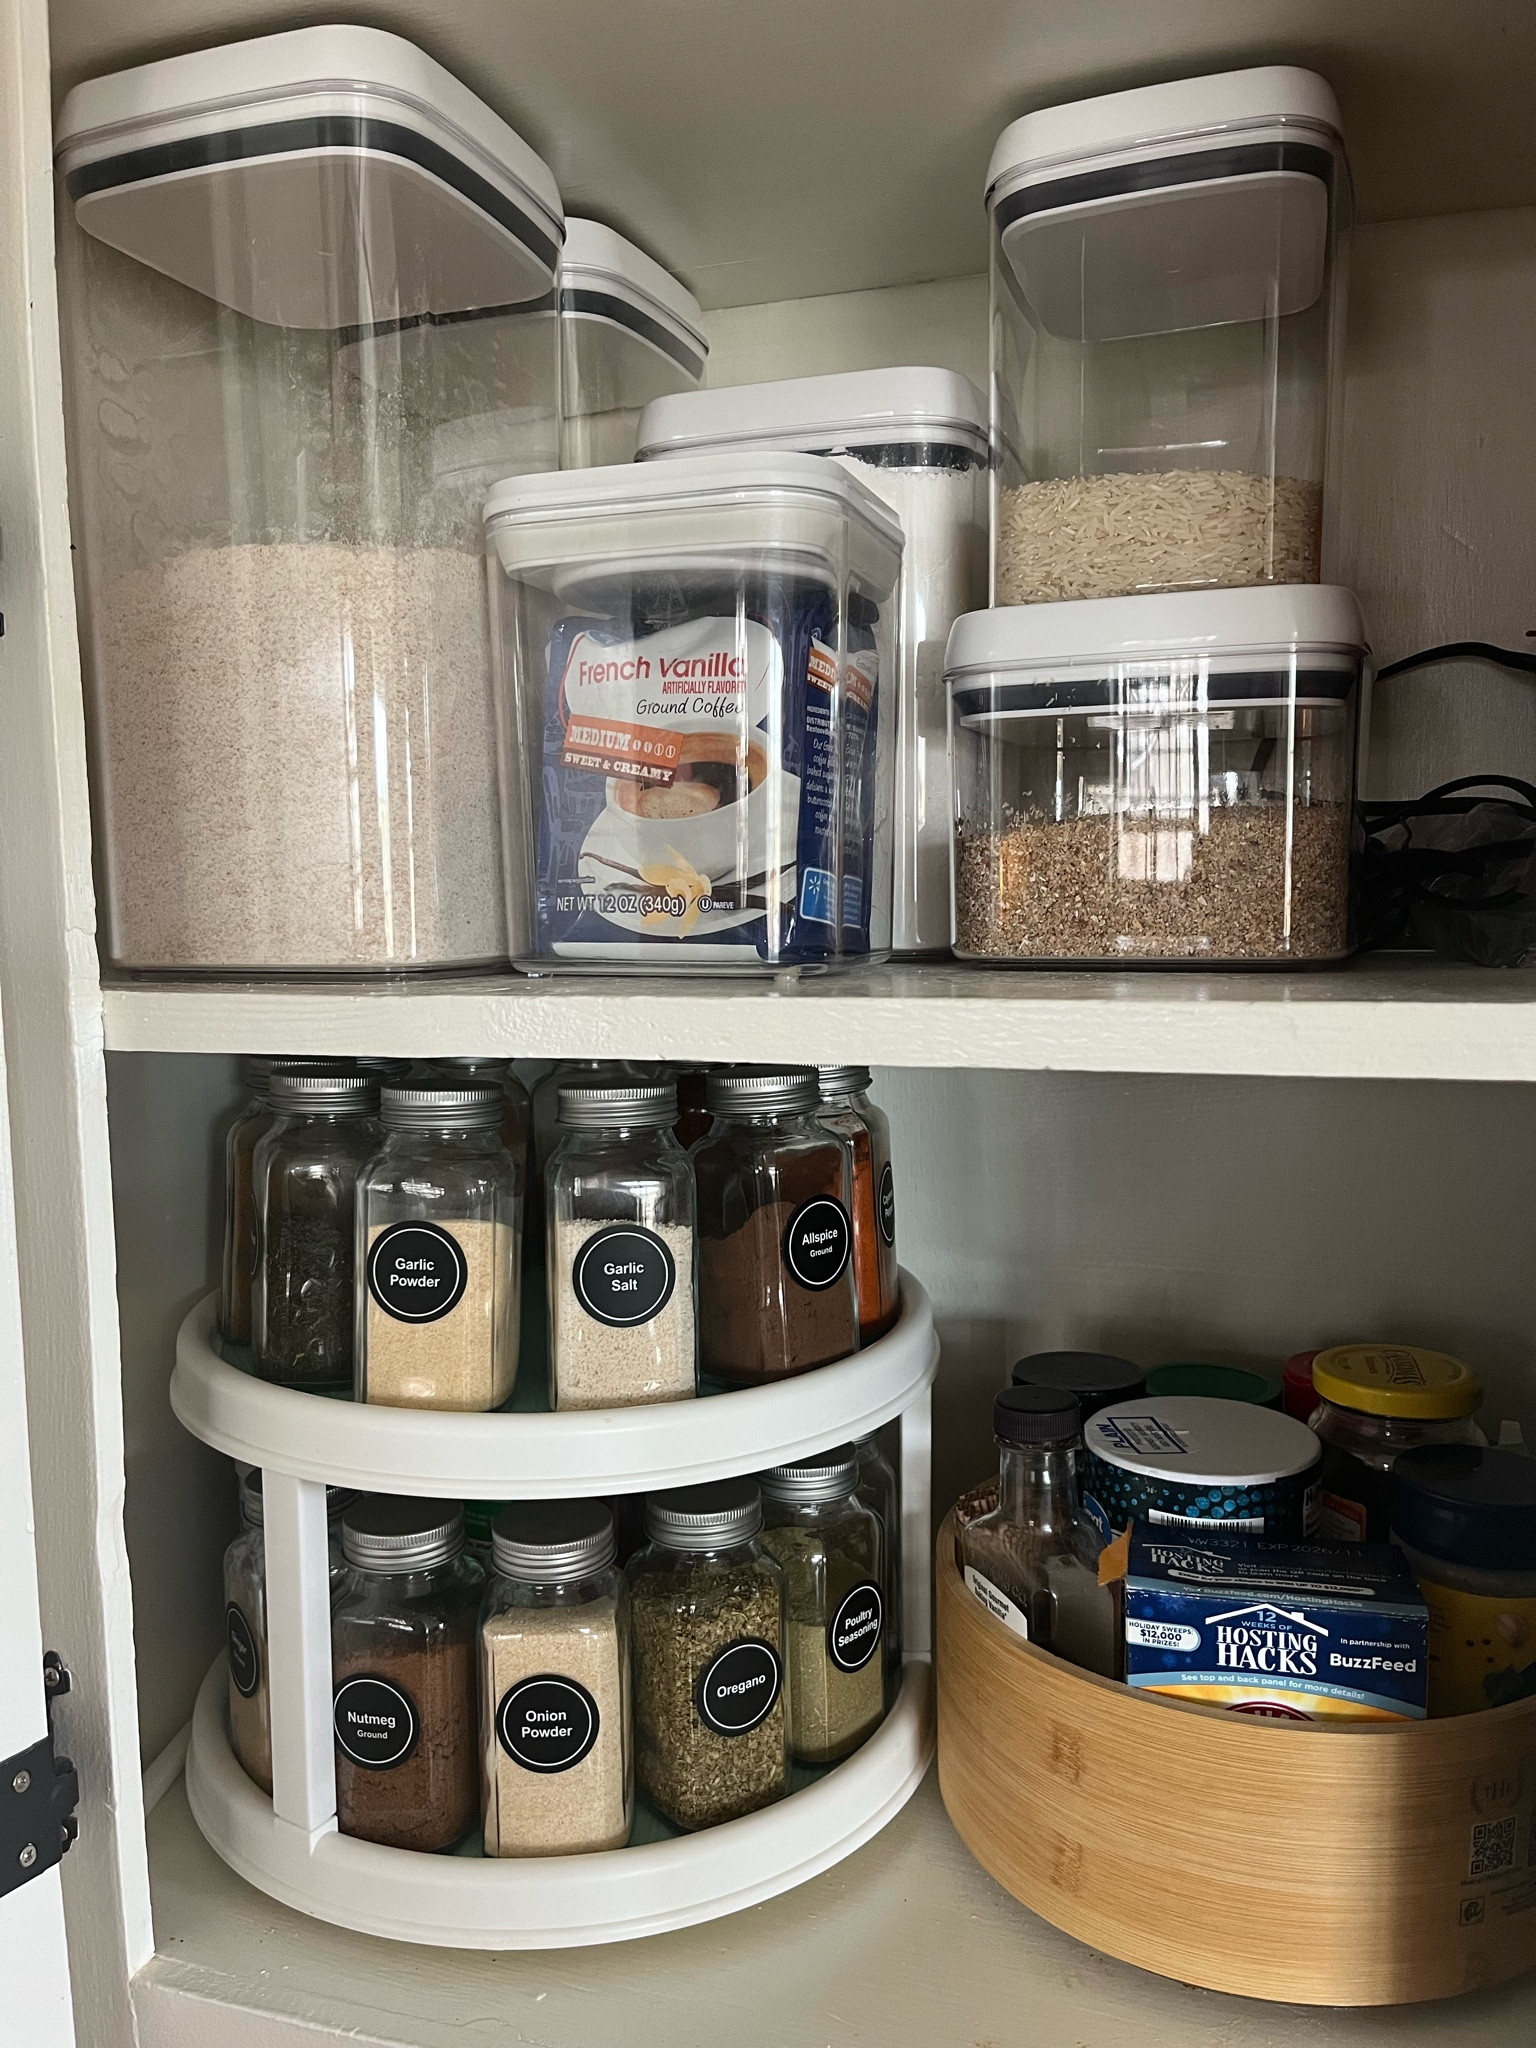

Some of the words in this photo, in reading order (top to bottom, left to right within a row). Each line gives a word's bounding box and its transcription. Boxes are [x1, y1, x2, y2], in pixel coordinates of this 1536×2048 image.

[579, 656, 650, 686] French
[659, 653, 746, 678] Vanilla
[662, 681, 707, 695] ARTIFICIALLY
[636, 697, 690, 715] Ground
[569, 725, 632, 752] MEDIUM
[564, 752, 602, 768] SWEET
[602, 759, 612, 771] &
[613, 761, 673, 782] CREAMY
[557, 896, 575, 912] NET
[576, 896, 595, 912] WT
[599, 896, 615, 912] 12
[618, 896, 637, 912] OZ
[639, 895, 685, 916] (340g)
[801, 1229, 838, 1246] Allspice
[809, 1245, 833, 1258] Ground
[395, 1257, 435, 1271] Garlic
[603, 1262, 645, 1275] Garlic
[390, 1274, 440, 1288] Powder
[611, 1278, 638, 1292] Salt
[1151, 1553, 1225, 1574] HACKS
[844, 1607, 873, 1630] Poultry
[1256, 1610, 1277, 1623] 12
[1128, 1621, 1160, 1630] HOLIDAY
[1241, 1620, 1276, 1629] WEEKS
[838, 1618, 878, 1647] Seasoning
[1140, 1628, 1182, 1642] $12,000
[1216, 1625, 1318, 1653] HOSTING
[1152, 1639, 1180, 1648] PRIZES!
[1349, 1638, 1392, 1649] partnership
[1216, 1642, 1318, 1676] HACKS
[1329, 1652, 1418, 1673] BuzzFeed
[716, 1674, 766, 1698] Oregano
[1181, 1673, 1199, 1682] See
[1199, 1674, 1216, 1683] top
[1217, 1674, 1235, 1682] and
[1237, 1675, 1259, 1684] back
[1261, 1677, 1287, 1688] panel
[1288, 1680, 1303, 1689] for
[1304, 1684, 1329, 1693] more
[1330, 1687, 1366, 1701] details!
[347, 1710, 396, 1729] Nutmeg
[525, 1710, 567, 1722] Onion
[356, 1729, 388, 1739] Ground
[521, 1725, 573, 1738] Powder
